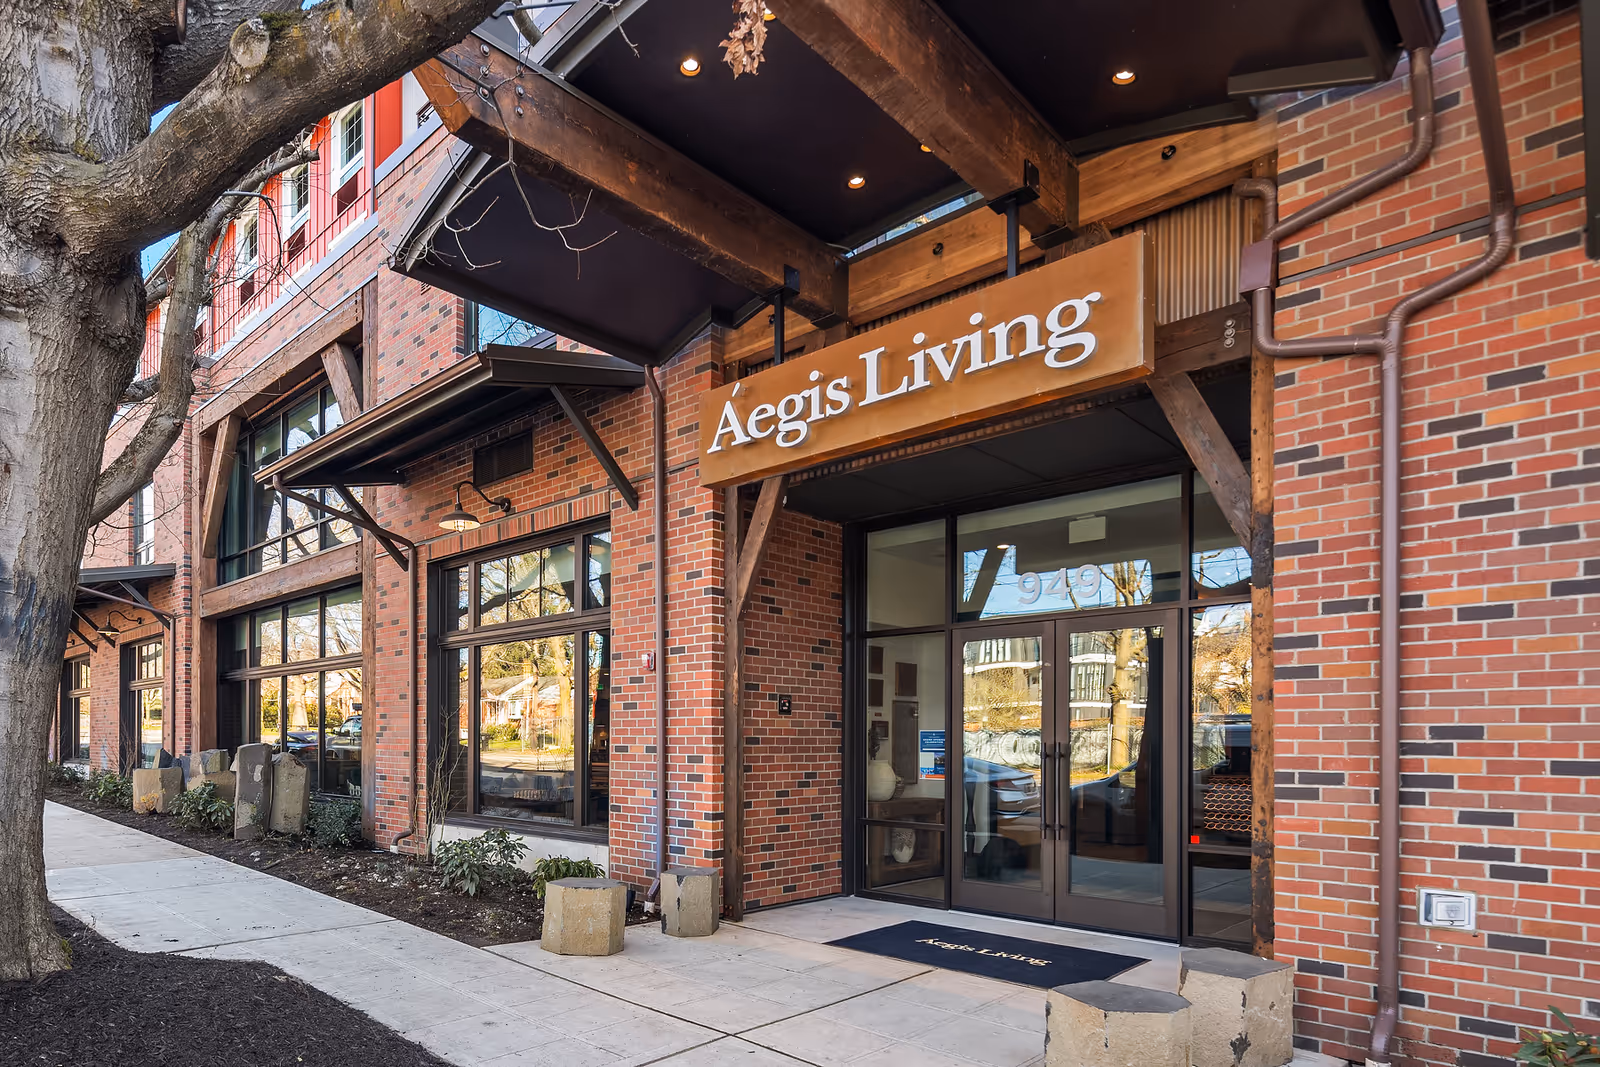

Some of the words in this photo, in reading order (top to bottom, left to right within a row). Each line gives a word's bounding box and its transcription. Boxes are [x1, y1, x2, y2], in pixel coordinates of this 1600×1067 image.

[706, 370, 853, 454] Áegis
[858, 291, 1102, 407] Living
[1017, 564, 1102, 604] 949
[975, 948, 1052, 966] Living
